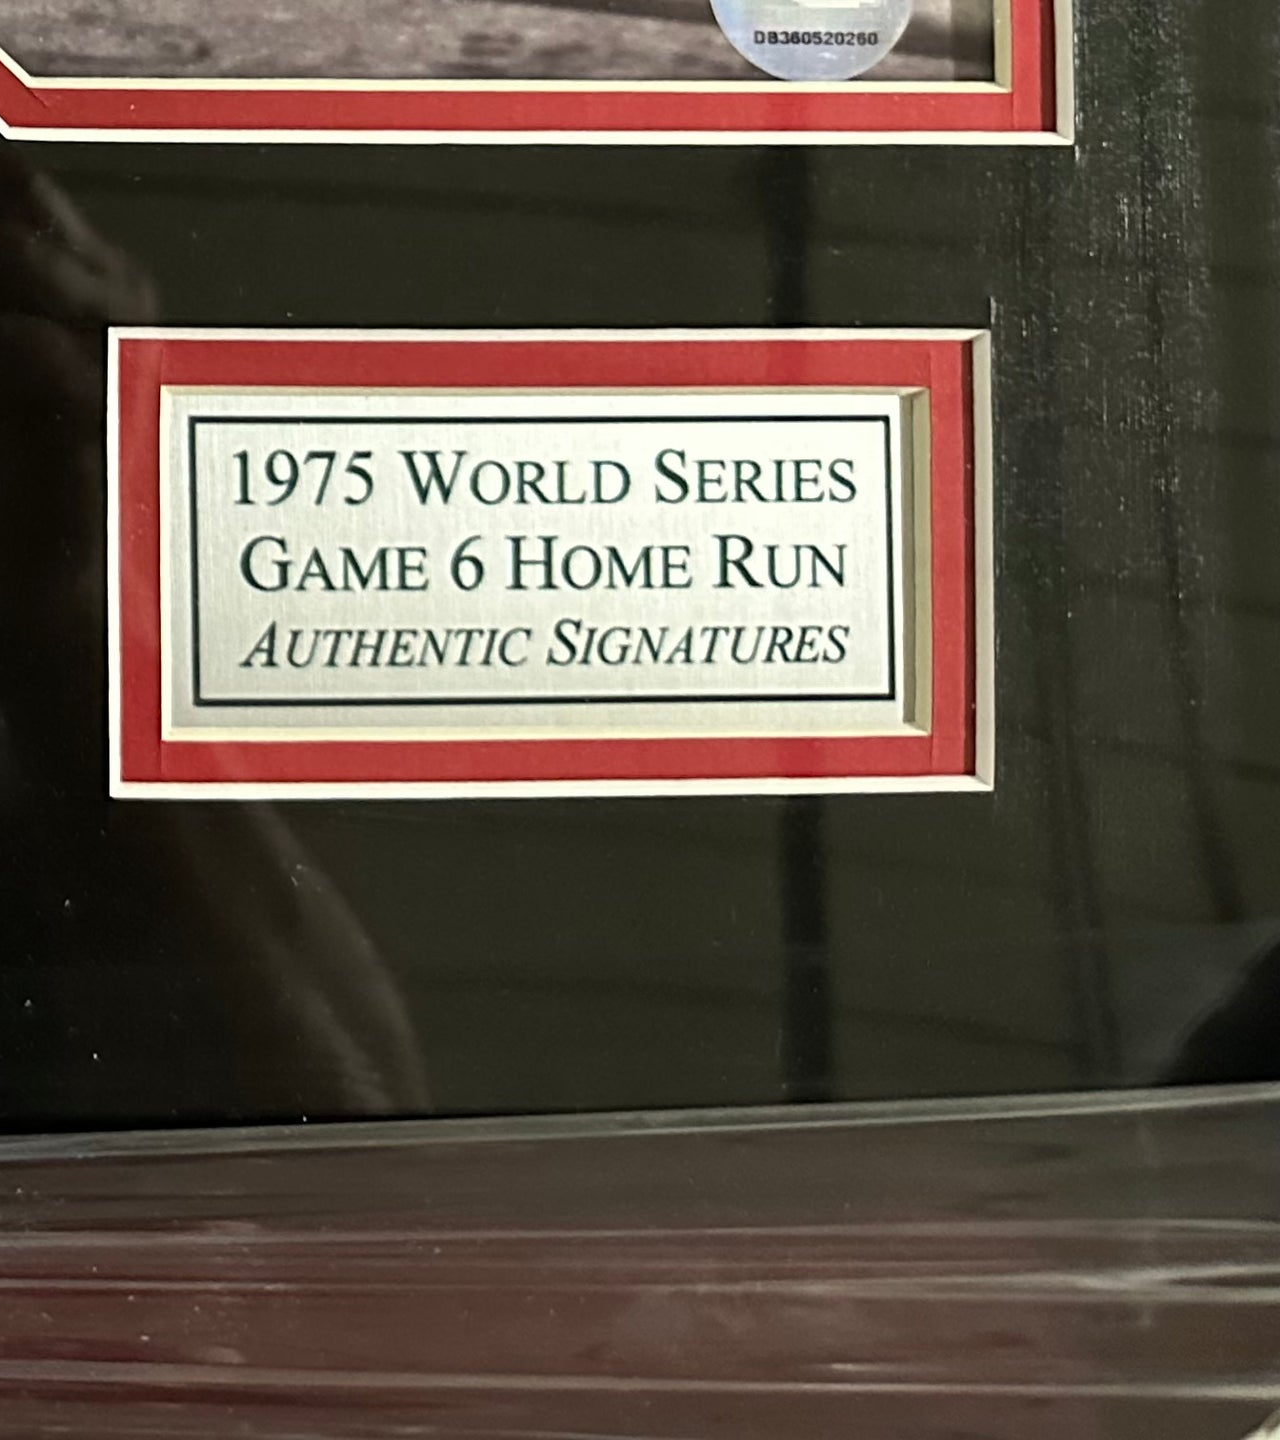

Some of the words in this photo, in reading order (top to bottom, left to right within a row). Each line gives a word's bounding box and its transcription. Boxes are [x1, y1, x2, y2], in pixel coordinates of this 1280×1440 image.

[231, 449, 376, 506] 1975
[398, 449, 632, 506] WORLD
[653, 448, 858, 504] SERIES
[239, 535, 429, 593] GAME
[449, 534, 485, 591] 6
[505, 535, 693, 591] HOME
[712, 533, 848, 590] RUN
[238, 619, 532, 669] AUTHENTIC
[546, 617, 851, 668] SIGNATURES
